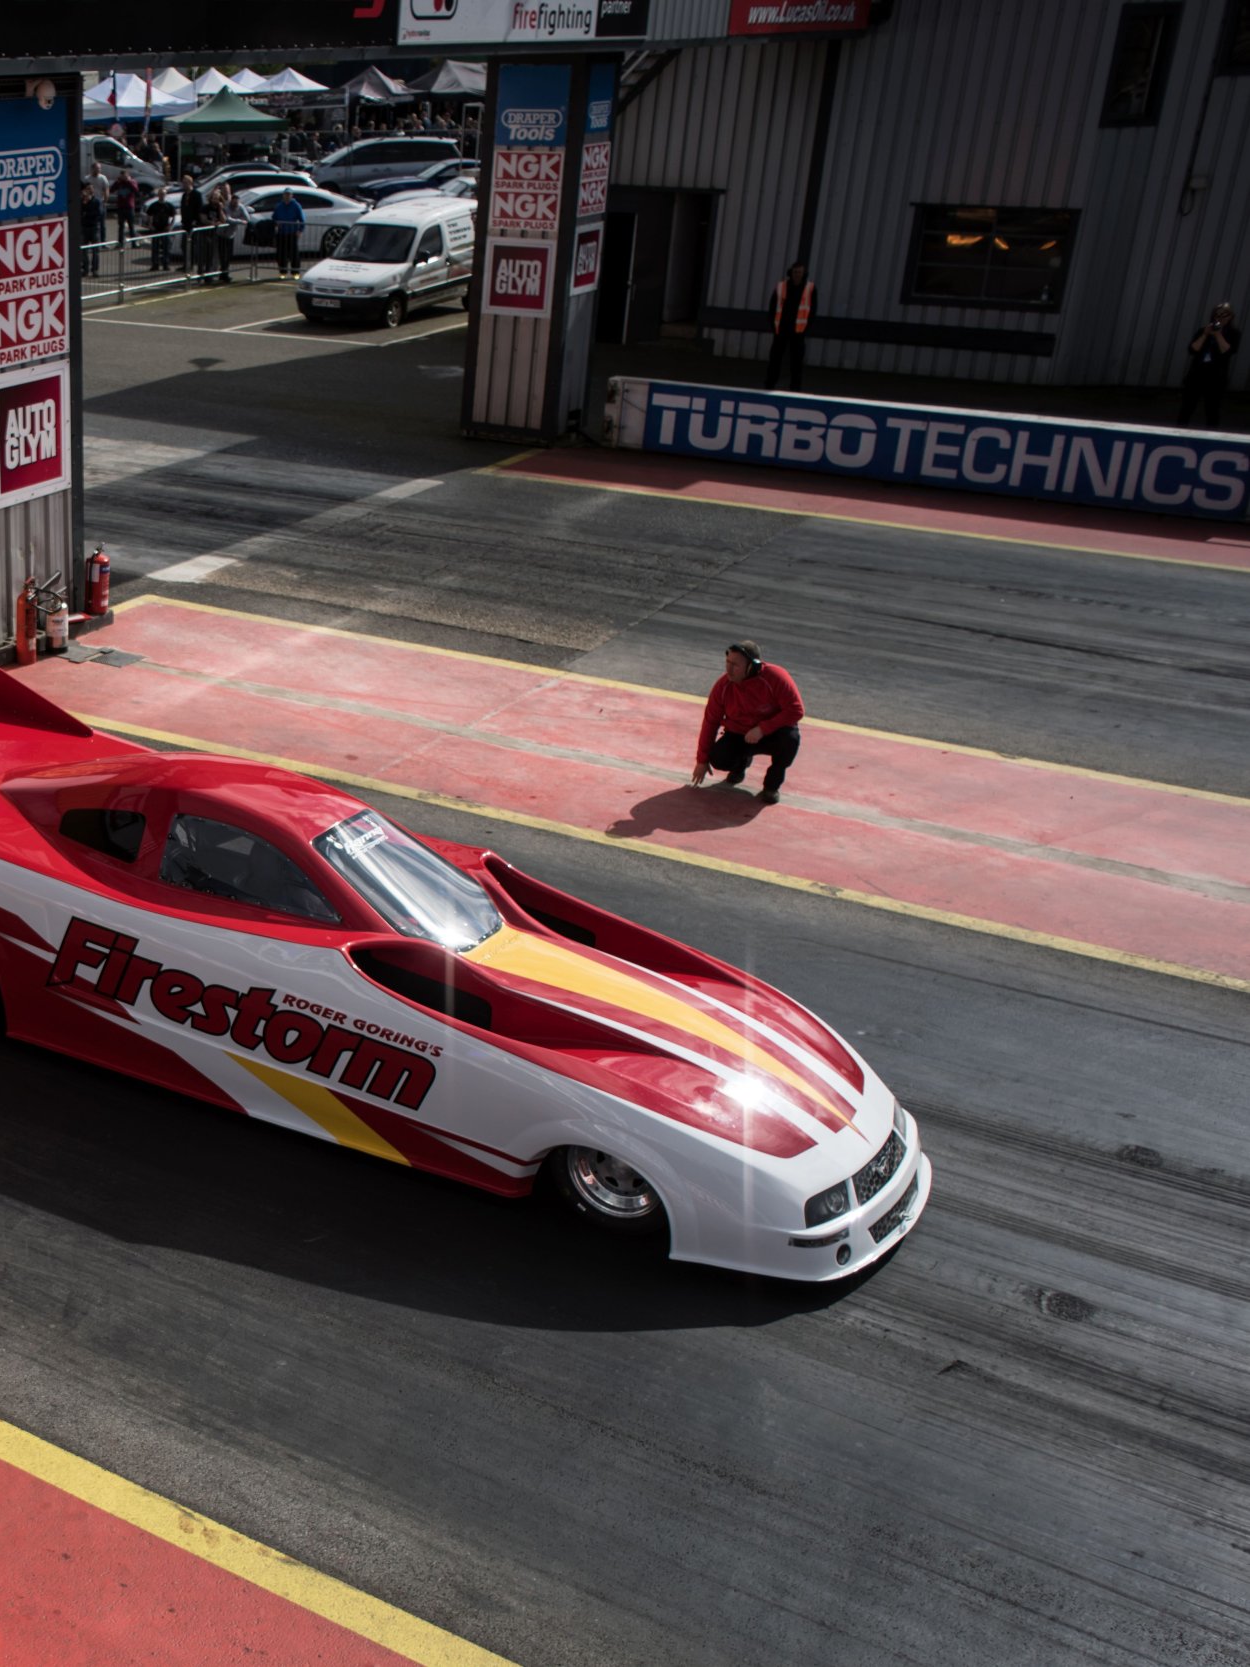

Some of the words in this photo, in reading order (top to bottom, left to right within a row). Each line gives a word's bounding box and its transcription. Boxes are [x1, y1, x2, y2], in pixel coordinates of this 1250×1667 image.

[512, 3, 592, 35] firefighting
[600, 0, 632, 18] partner
[748, 1, 855, 25] www.LucasOil.co.uk
[507, 113, 556, 125] DRAPER
[510, 124, 555, 141] Tools
[497, 154, 560, 180] NGK
[583, 145, 608, 171] NGK
[495, 181, 525, 189] SPARK
[527, 182, 559, 191] PLUGS
[580, 181, 605, 207] NGK
[494, 193, 557, 220] NGK
[492, 220, 522, 229] SPARK
[524, 221, 556, 231] PLUGS
[29, 271, 65, 290] PLUGS
[498, 258, 542, 281] AUTO
[495, 276, 540, 296] GLYM
[30, 340, 65, 358] PLUGS
[6, 398, 56, 441] AUTO
[5, 427, 56, 470] GLYM
[652, 392, 877, 469] TURBO
[885, 417, 1248, 512] TECHNICS
[46, 916, 437, 1111] Firestorm
[282, 993, 348, 1025] ROGER
[352, 1017, 443, 1058] GORING'S
